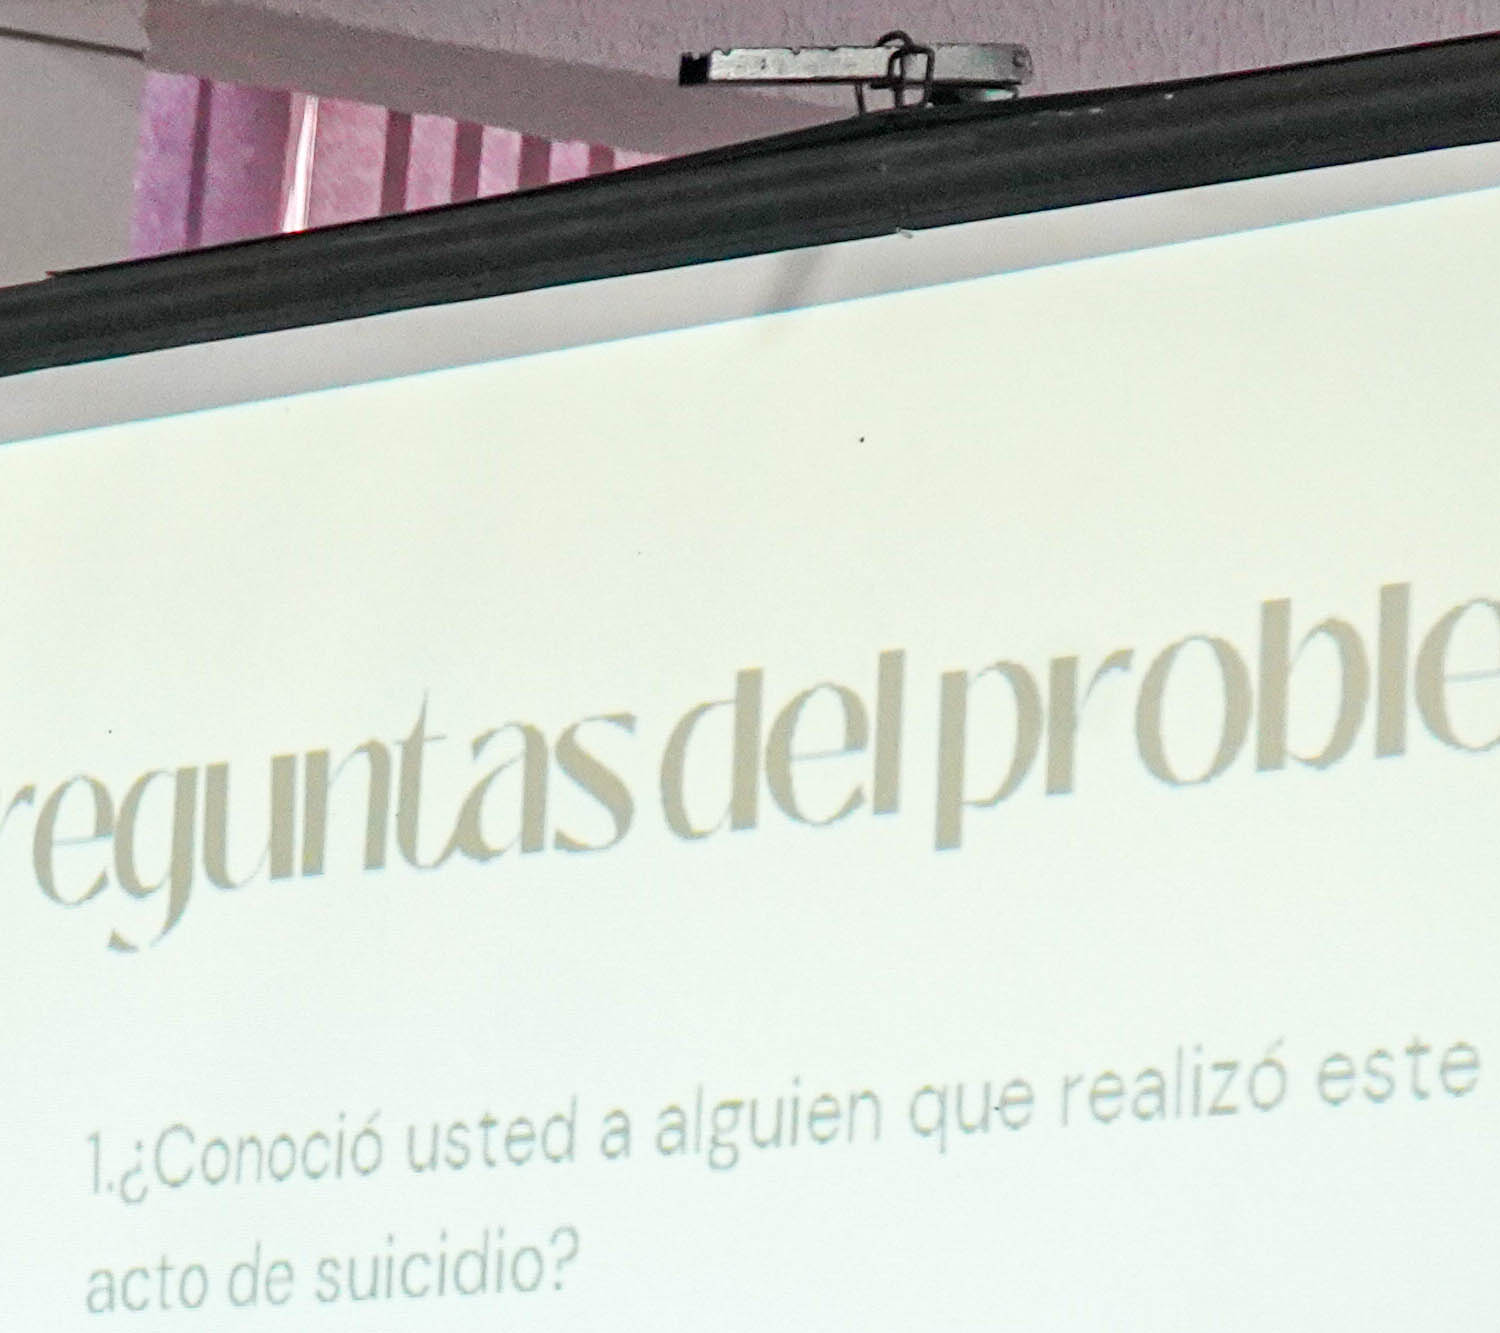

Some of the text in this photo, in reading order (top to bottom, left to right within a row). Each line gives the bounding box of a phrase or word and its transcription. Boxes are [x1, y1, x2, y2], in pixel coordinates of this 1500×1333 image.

[656, 646, 909, 845] del
[404, 1094, 580, 1176] usted
[597, 1106, 634, 1163] a
[652, 1074, 884, 1174] alguien
[906, 1075, 1037, 1157] que
[1059, 1036, 1290, 1128] realizó
[1313, 1035, 1483, 1110] este
[83, 1223, 582, 1317] acto de suicidio?
